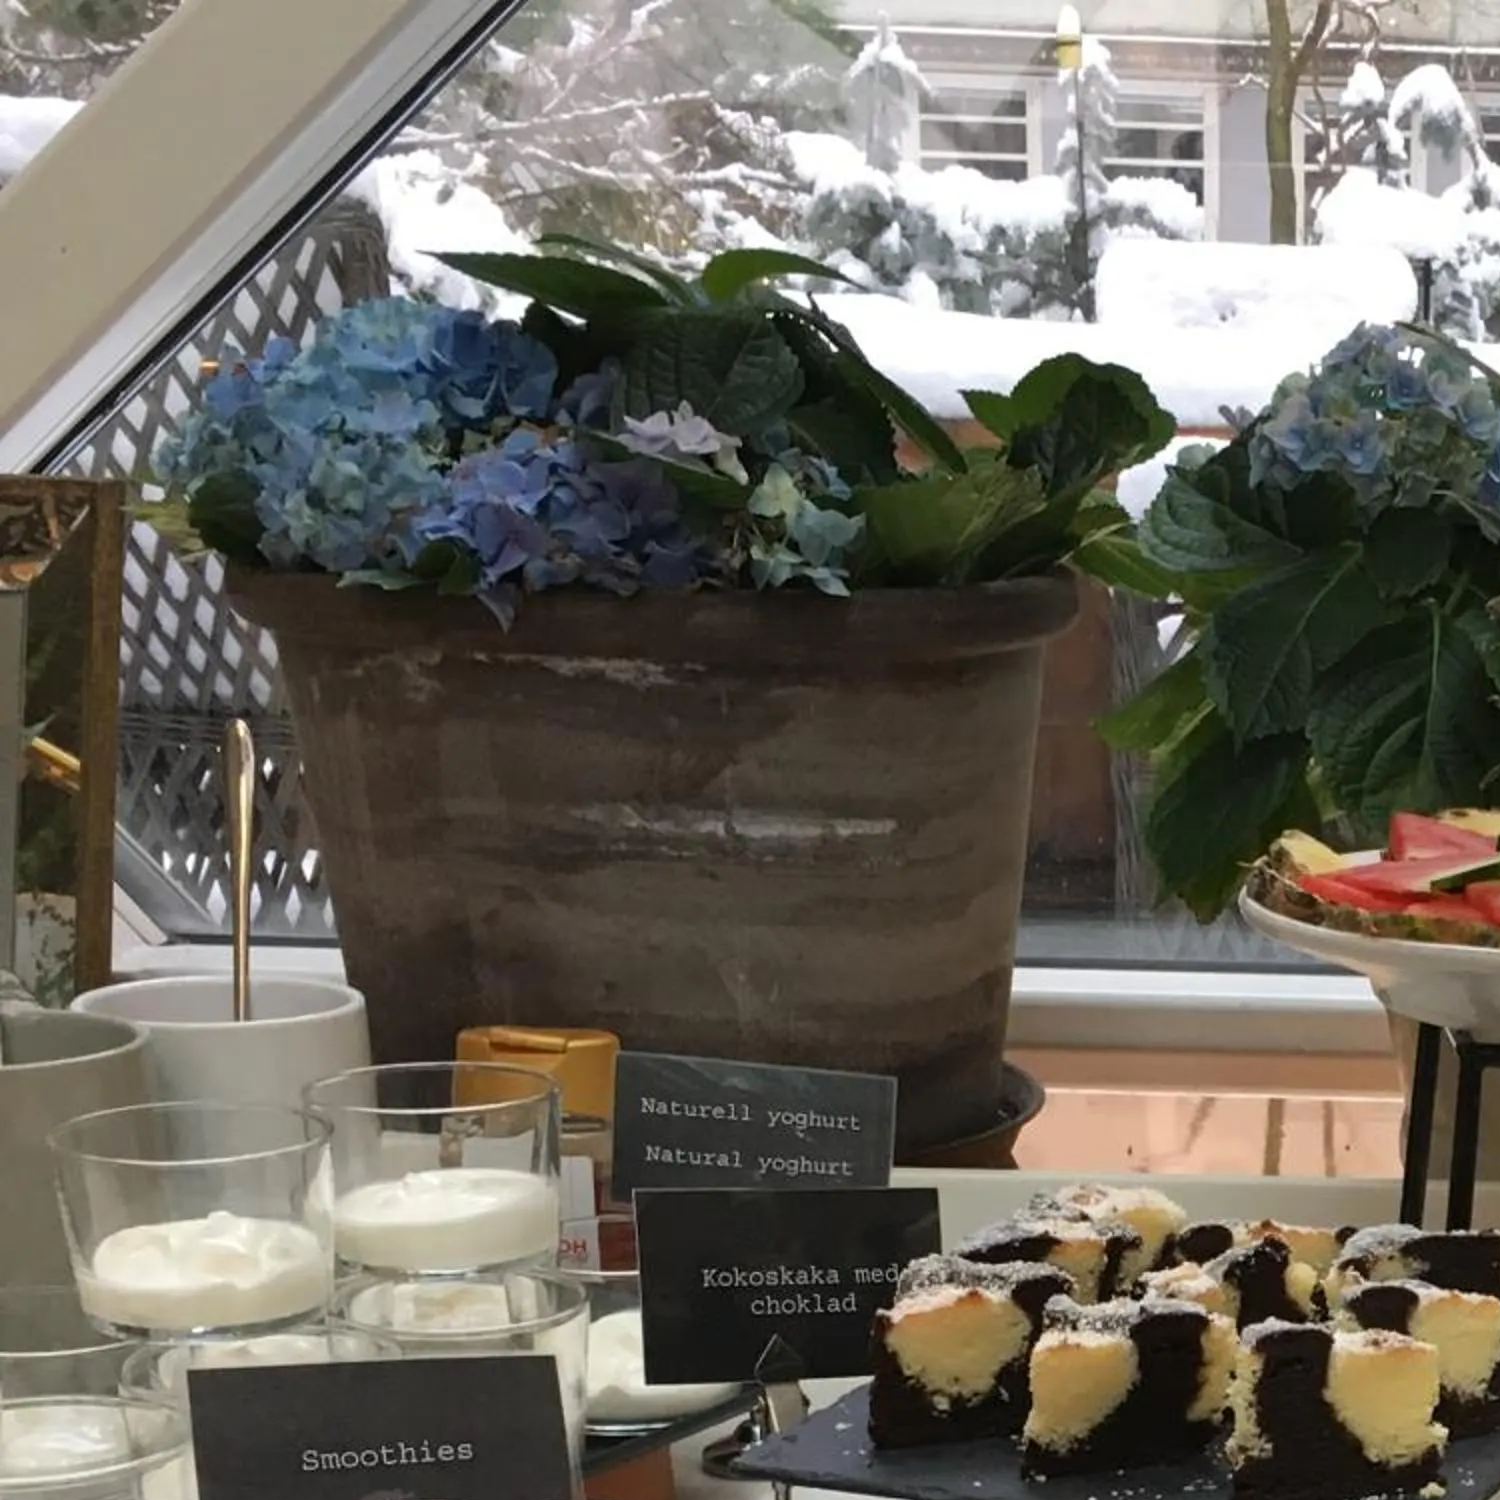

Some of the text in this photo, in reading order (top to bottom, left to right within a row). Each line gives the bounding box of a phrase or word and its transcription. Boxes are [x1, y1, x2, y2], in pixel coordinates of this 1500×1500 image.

[640, 1097, 861, 1131] Naturell yoghurt
[645, 1145, 854, 1177] Natural yoghurt
[702, 1263, 899, 1288] Kokoskaka med
[750, 1292, 858, 1315] choklad
[302, 1440, 474, 1472] Smoothies
